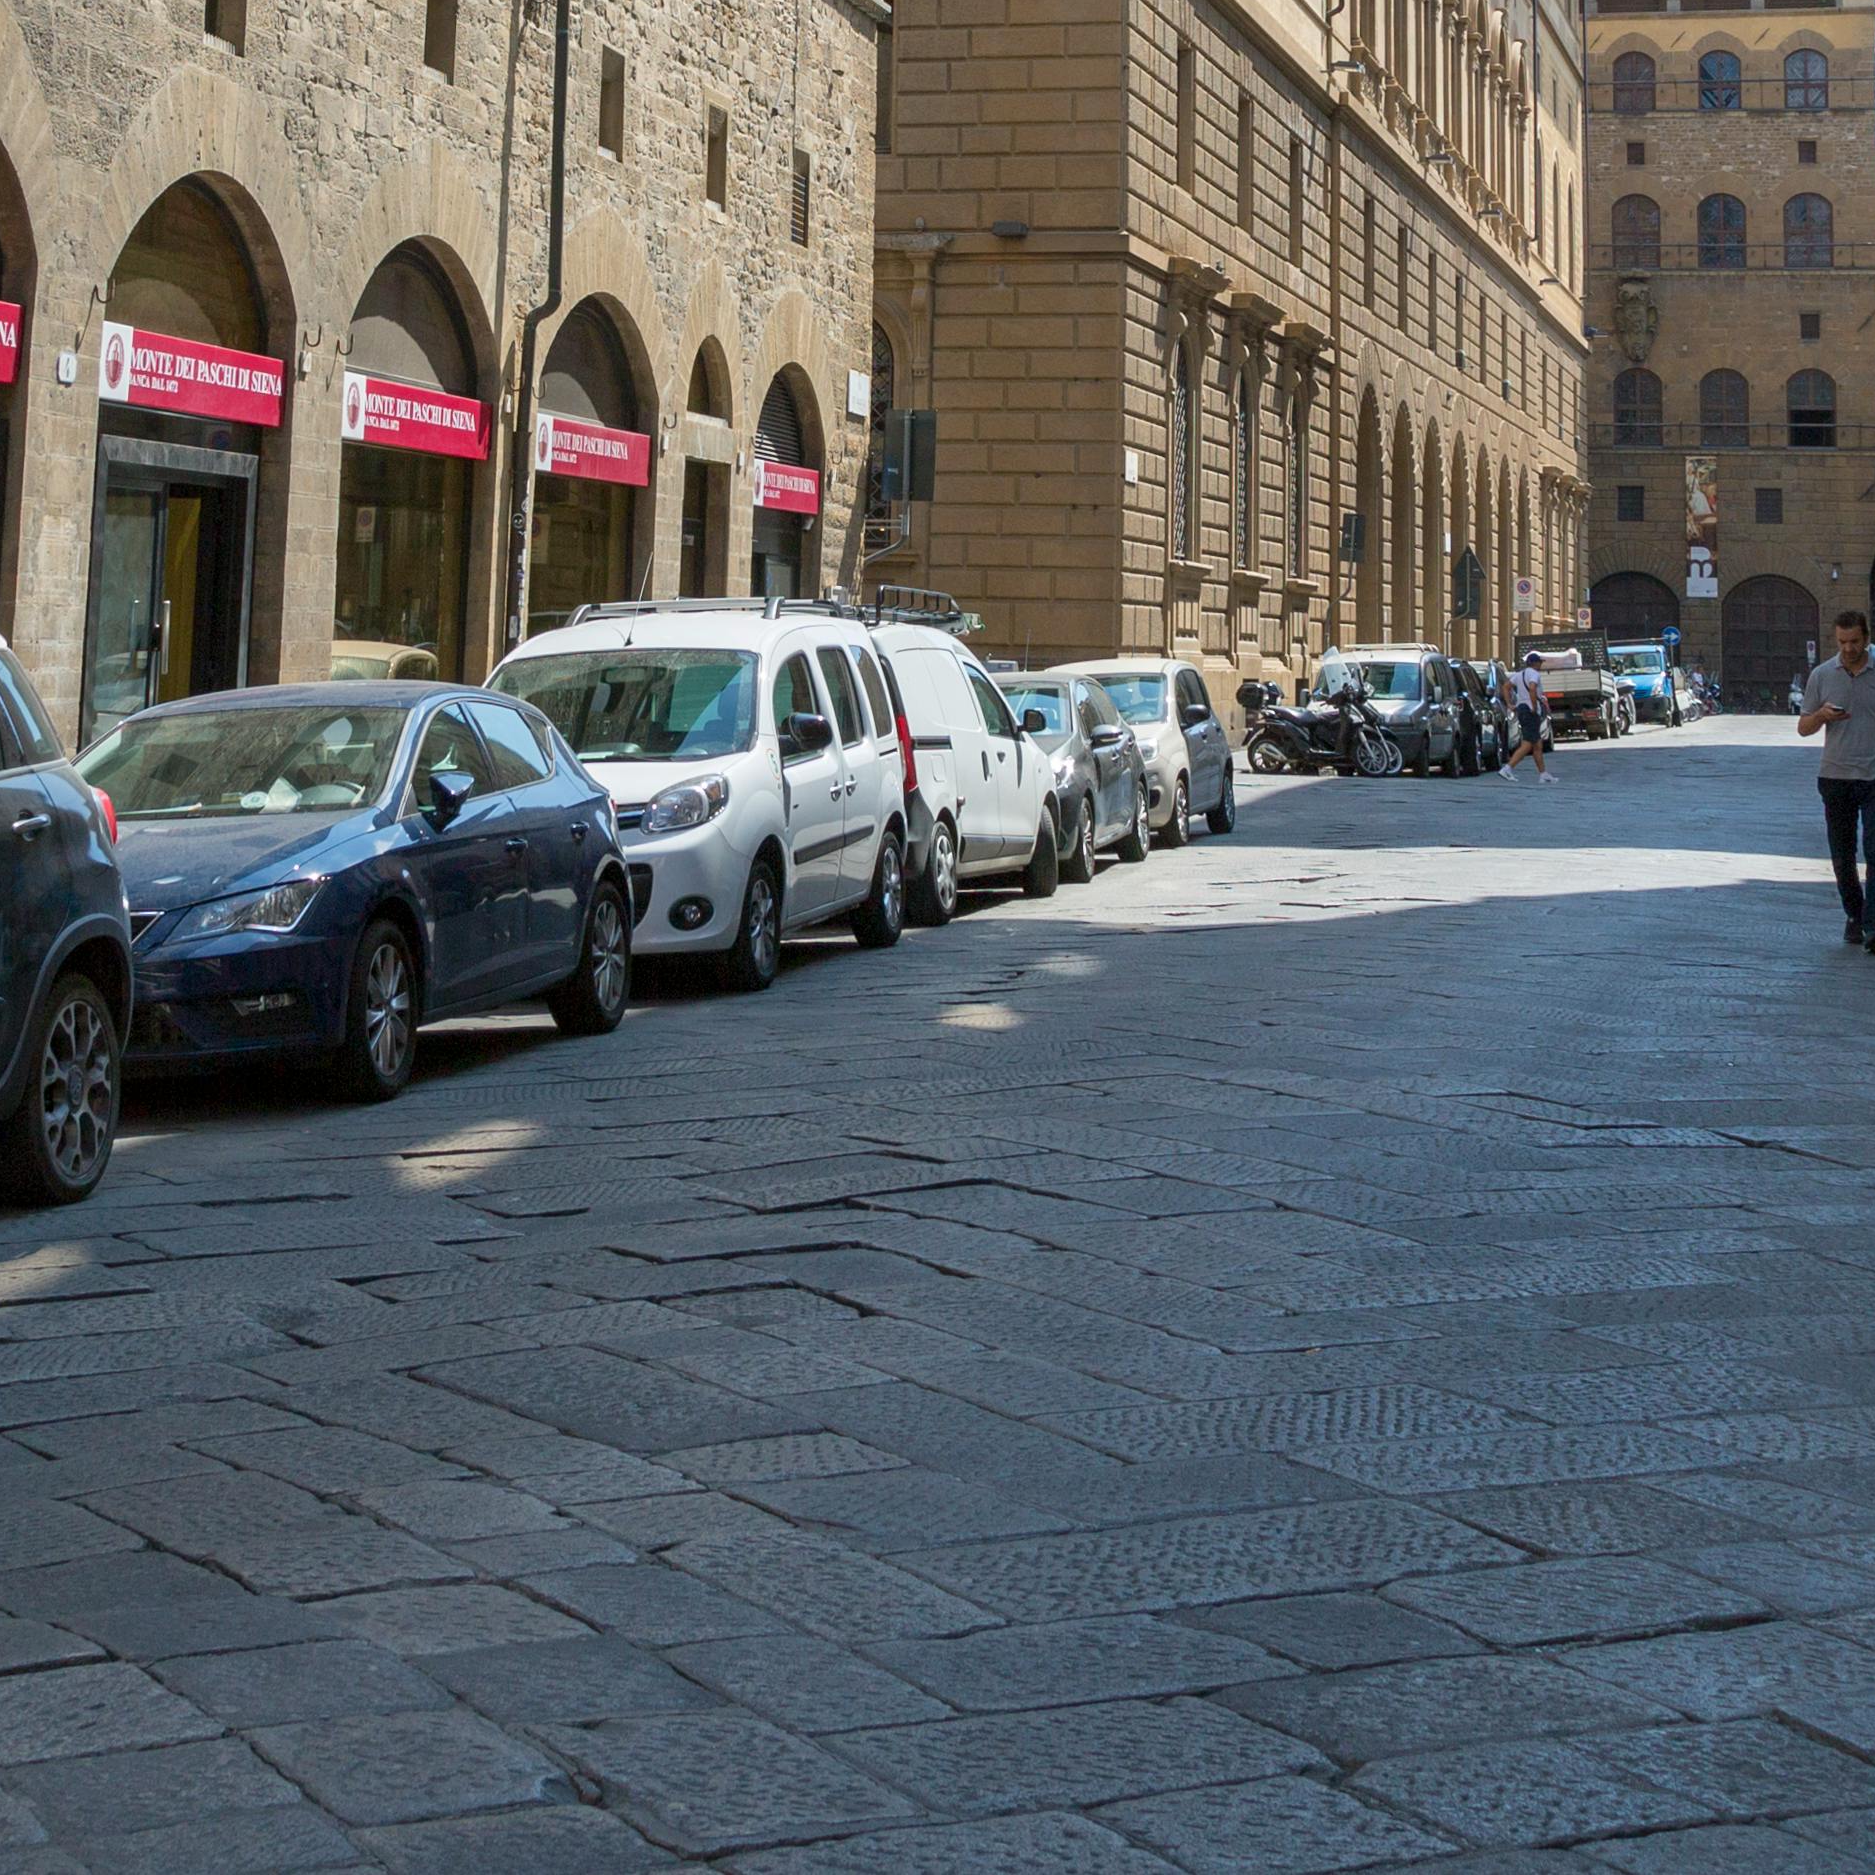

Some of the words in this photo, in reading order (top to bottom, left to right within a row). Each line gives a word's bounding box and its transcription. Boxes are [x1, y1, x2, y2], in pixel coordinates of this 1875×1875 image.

[130, 347, 173, 375] MONTE
[175, 356, 195, 380] DEI
[197, 360, 237, 390] PASCHI
[238, 369, 250, 391] DI
[251, 372, 283, 397] SIENA
[396, 398, 412, 419] DEI
[412, 401, 442, 426] PASCHI
[442, 407, 452, 427] DI
[452, 409, 476, 432] SIENA
